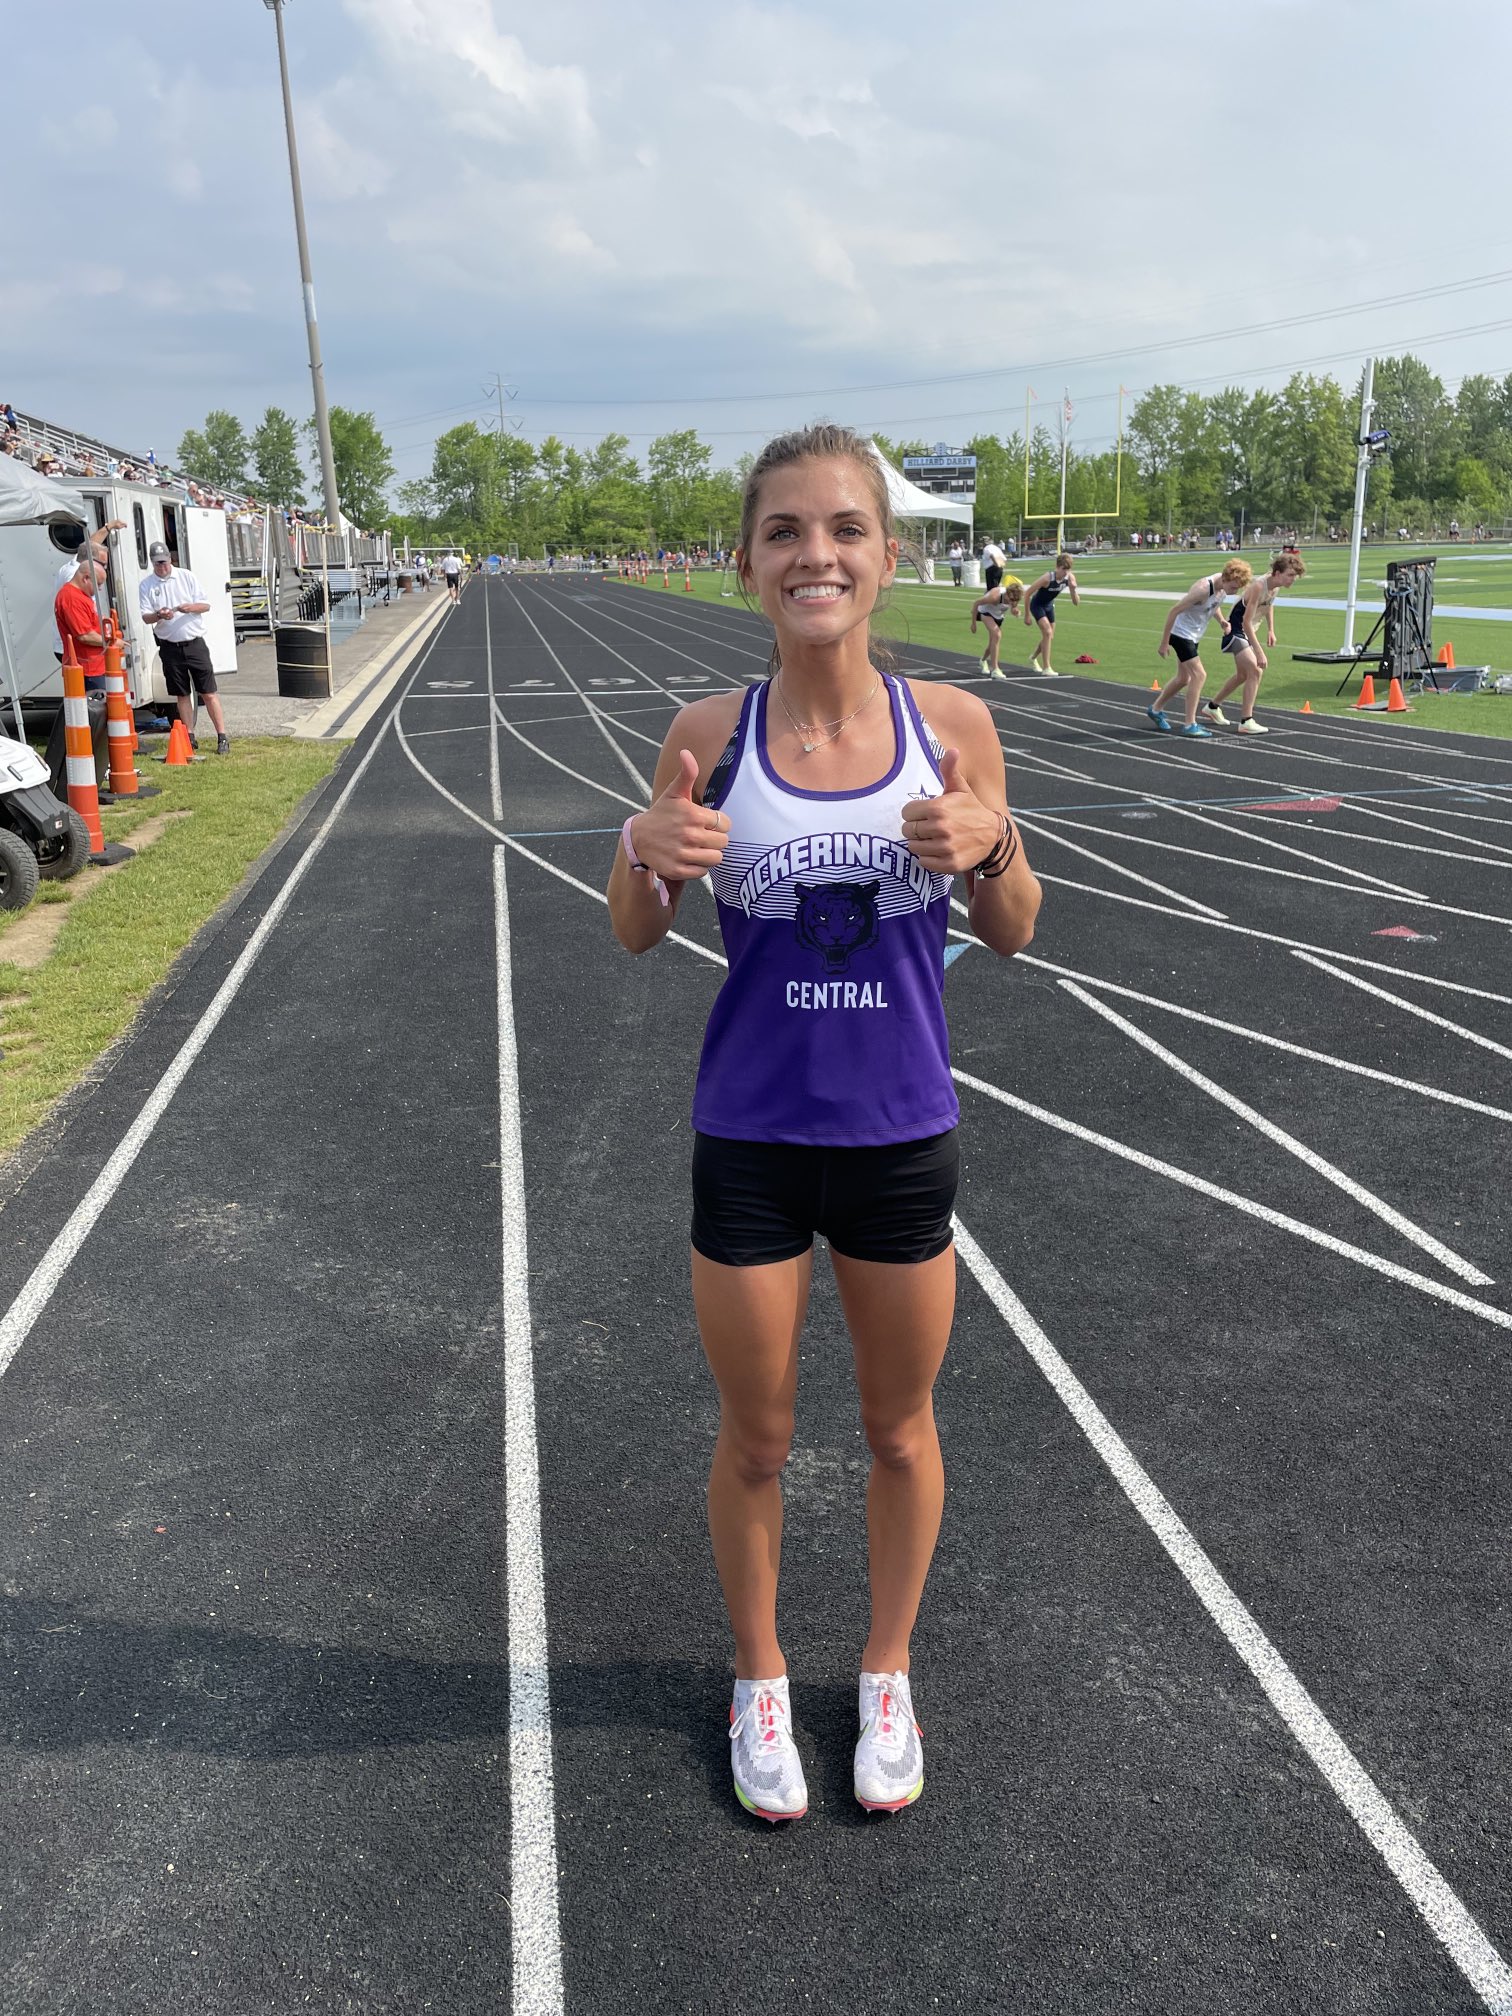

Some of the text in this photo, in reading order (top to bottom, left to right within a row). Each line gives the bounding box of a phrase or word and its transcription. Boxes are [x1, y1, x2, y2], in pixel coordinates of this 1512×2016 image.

[907, 457, 972, 467] HILLIARD DARBY
[738, 832, 934, 919] PICKERINGTON
[786, 981, 888, 1010] CENTRAL
